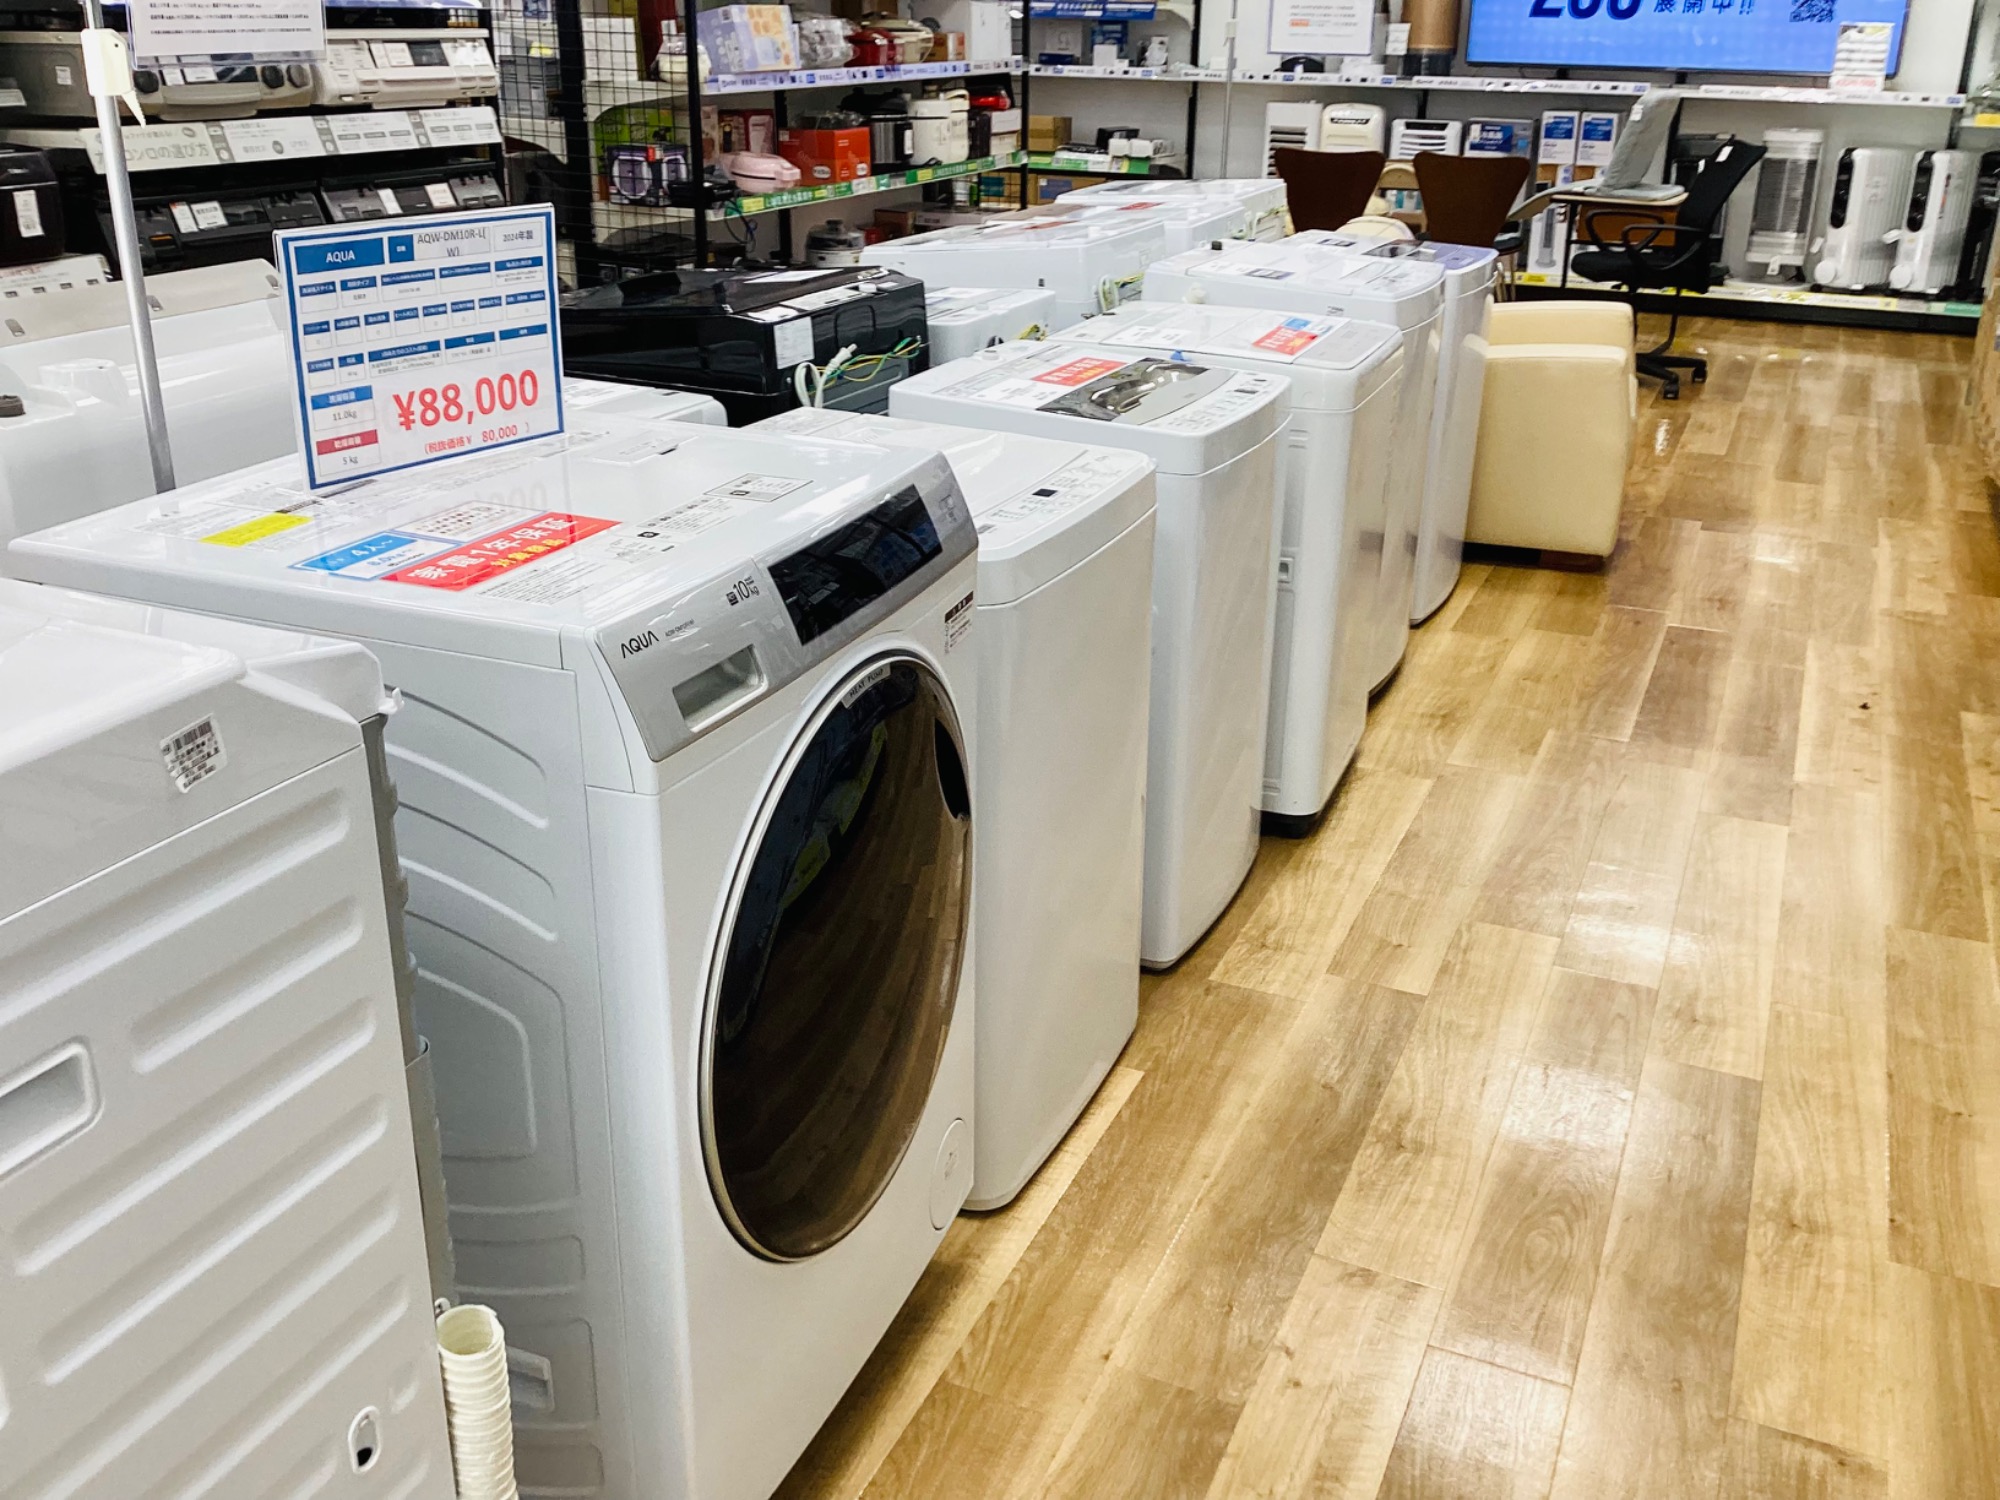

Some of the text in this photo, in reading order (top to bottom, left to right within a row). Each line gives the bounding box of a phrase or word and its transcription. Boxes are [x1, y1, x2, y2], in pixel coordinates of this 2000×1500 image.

[503, 230, 534, 242] 2024年製
[326, 250, 355, 263] AQUA
[393, 369, 538, 431] ¥88,000
[332, 410, 358, 422] 11.0kg
[482, 425, 518, 443] 80,000
[620, 630, 660, 658] AQUA
[849, 667, 884, 698] HEAT PUMP
